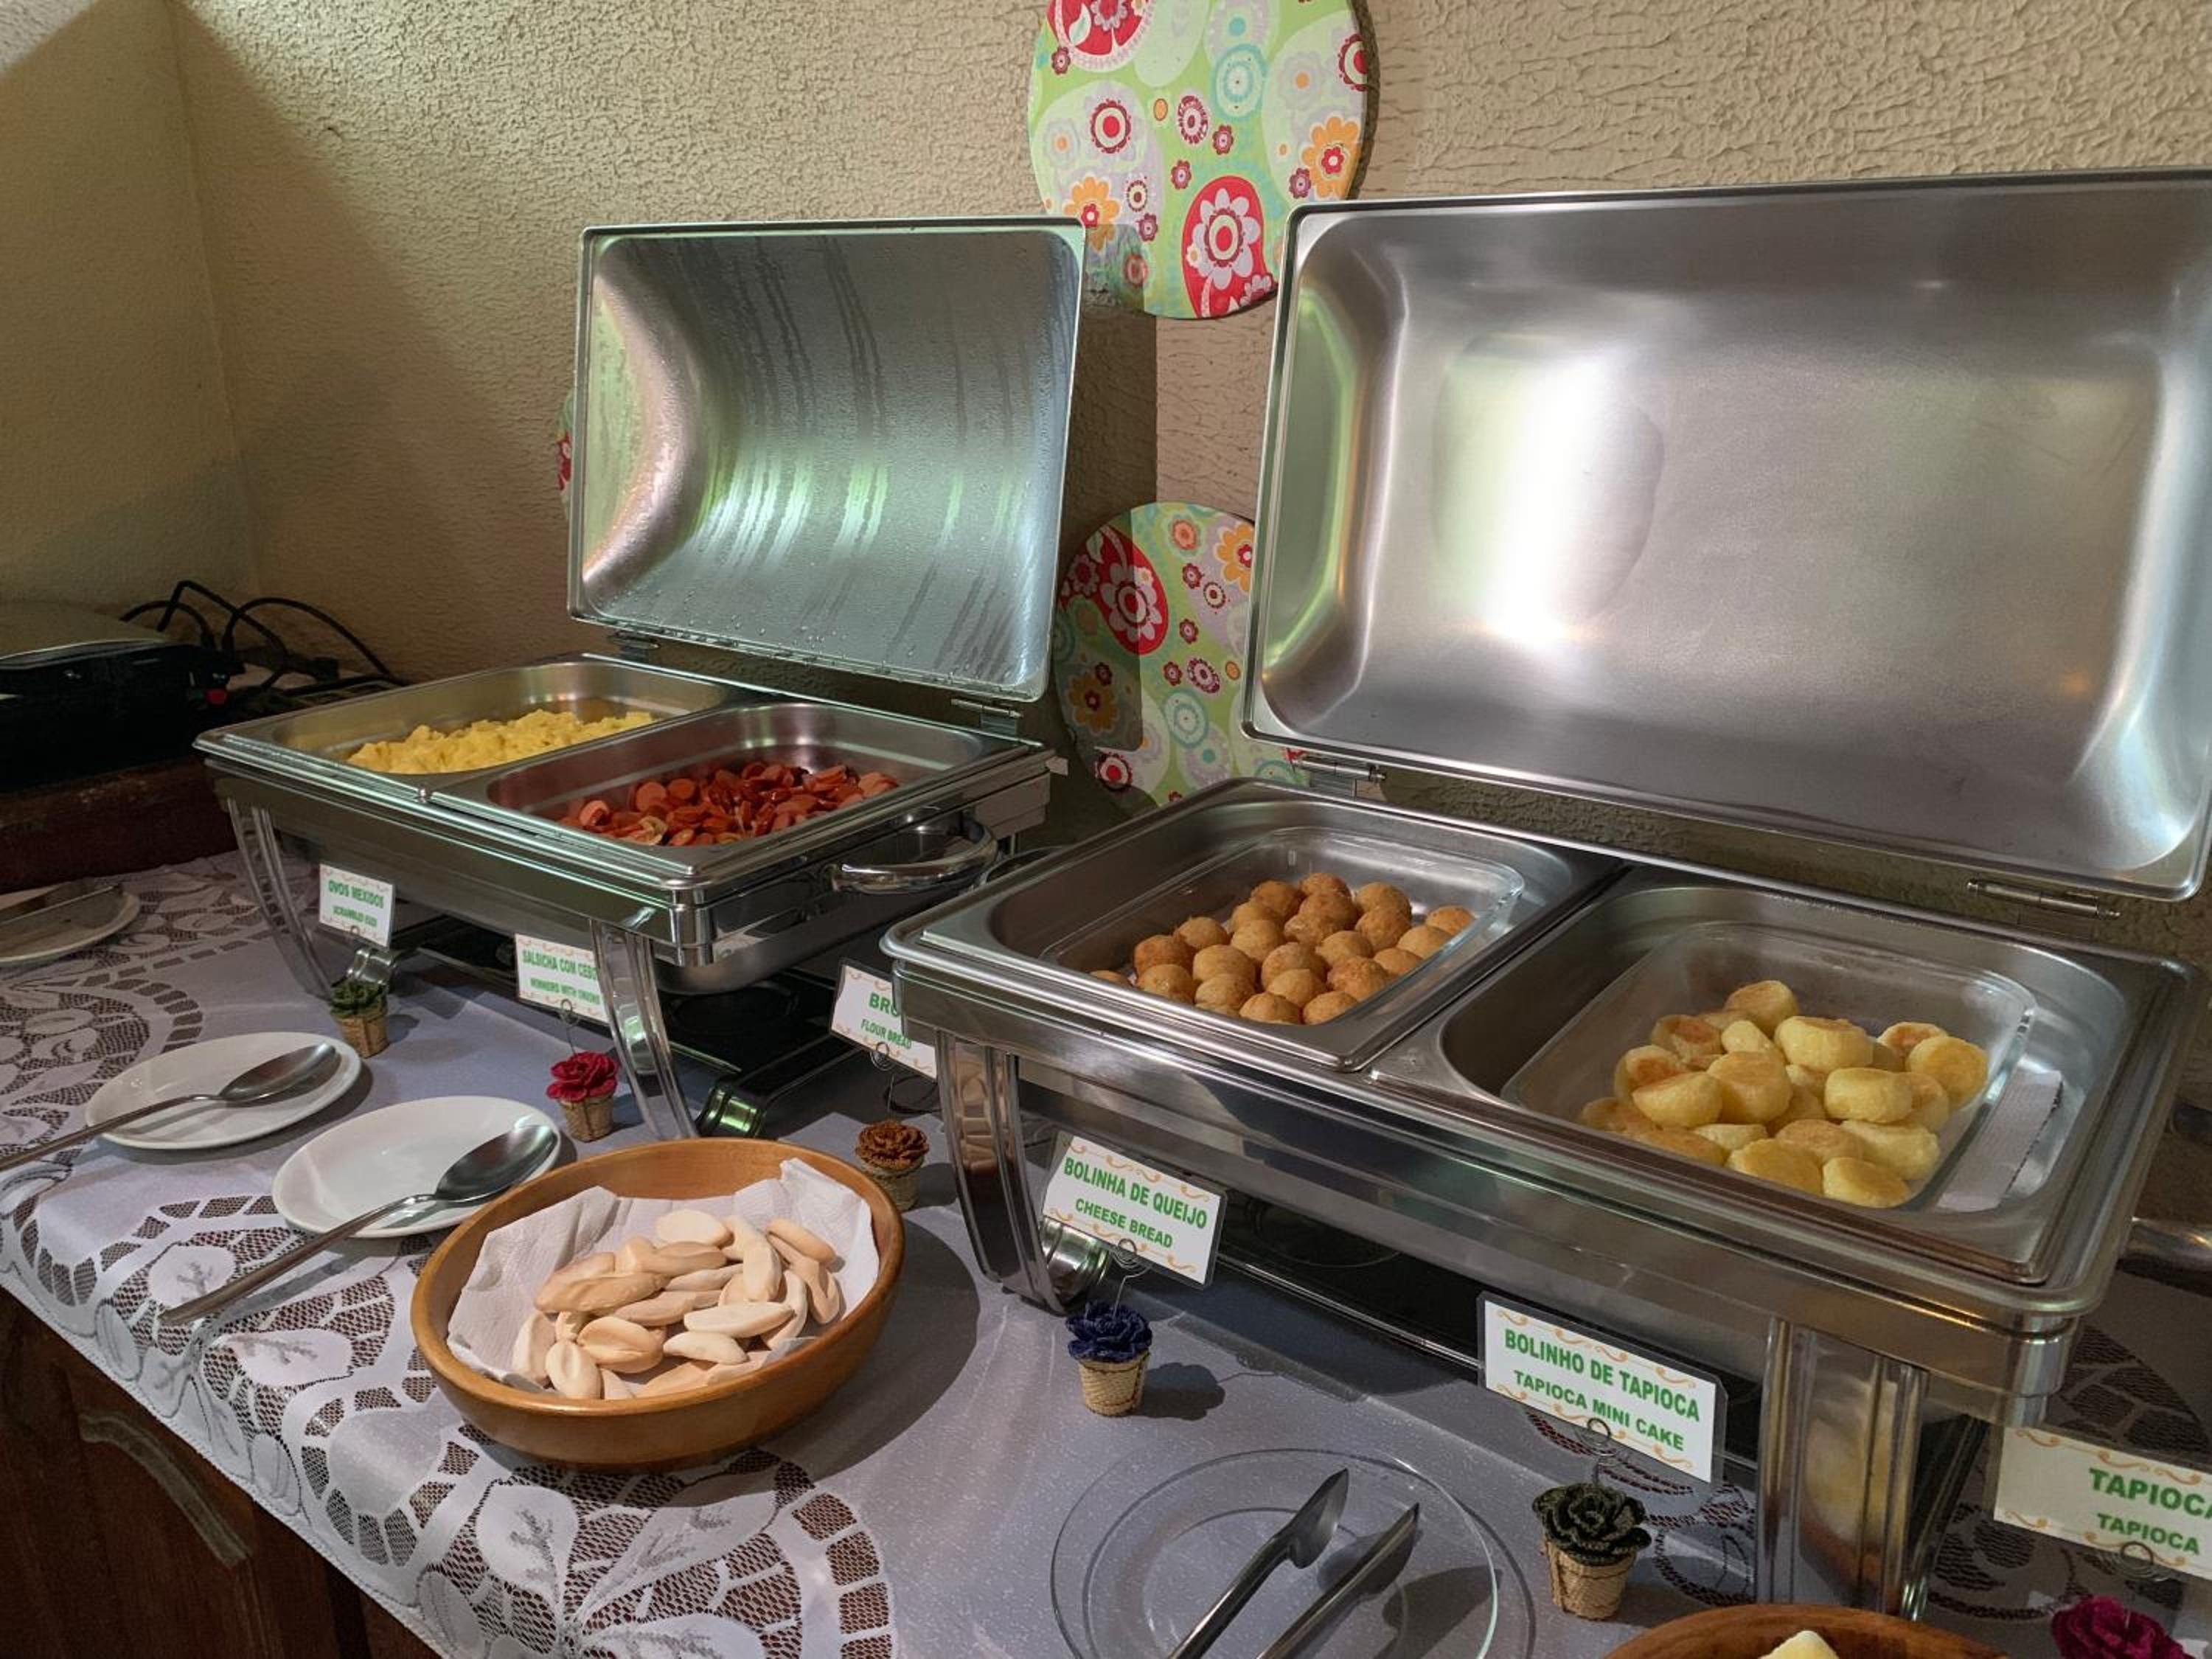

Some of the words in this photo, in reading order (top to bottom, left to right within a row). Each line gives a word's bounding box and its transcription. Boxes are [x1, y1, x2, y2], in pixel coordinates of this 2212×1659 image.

[861, 1019, 886, 1038] FLOUR
[888, 1032, 912, 1049] BREAD
[1064, 1157, 1126, 1197] BOLINHA
[1130, 1183, 1150, 1206] DE
[1153, 1192, 1207, 1229] QUEIJO
[1076, 1198, 1127, 1228] CHEESE
[1130, 1220, 1173, 1248] BREAD
[1505, 1329, 1585, 1374] BOLINHO
[1590, 1359, 1614, 1386] DE
[1619, 1370, 1700, 1422] TAPIOCA
[1514, 1370, 1587, 1410] TAPIOCA
[1593, 1399, 1630, 1428] MINI
[1635, 1419, 1684, 1451] CAKE
[2098, 1513, 2200, 1556] TAPIOCA
